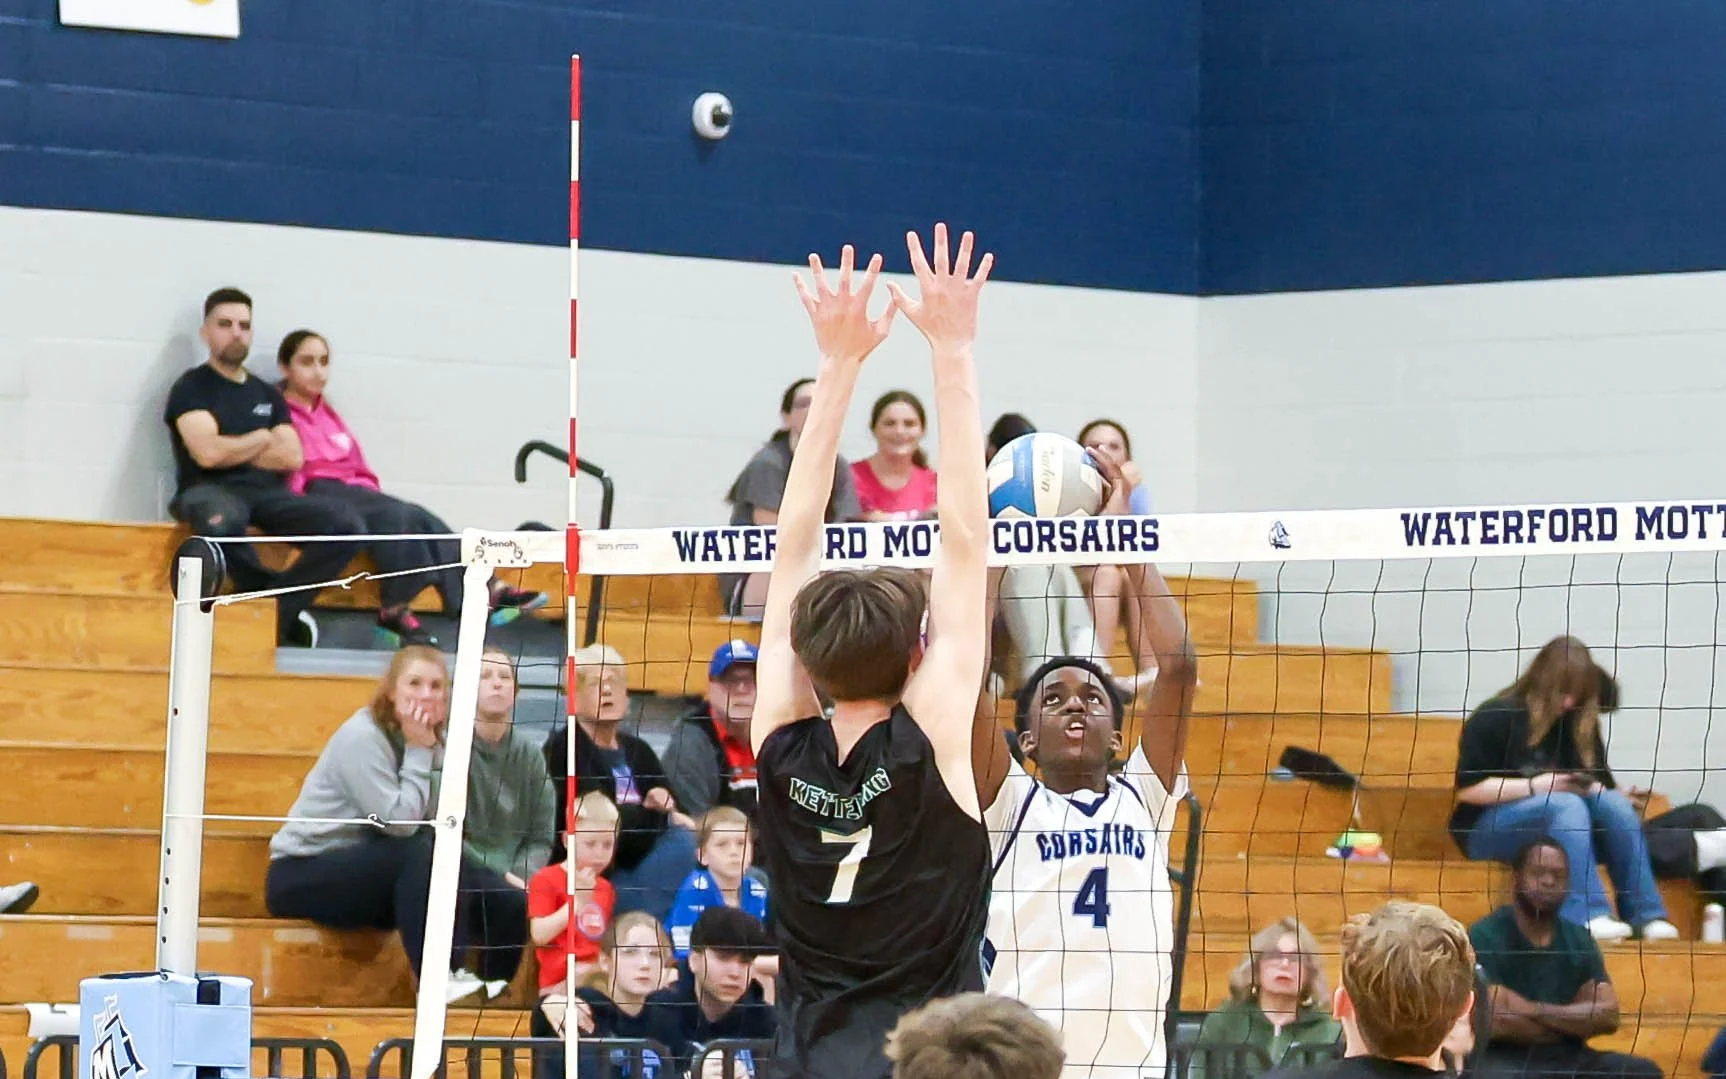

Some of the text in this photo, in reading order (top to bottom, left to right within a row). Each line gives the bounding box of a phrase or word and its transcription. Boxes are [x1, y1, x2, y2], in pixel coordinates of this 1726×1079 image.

[672, 526, 867, 562] WATERRD
[993, 518, 1159, 554] CORSAIRS
[1400, 507, 1617, 546] WATERFORD
[820, 824, 873, 903] 7
[1035, 823, 1146, 862] CORSAIRS
[1072, 866, 1111, 928] 4
